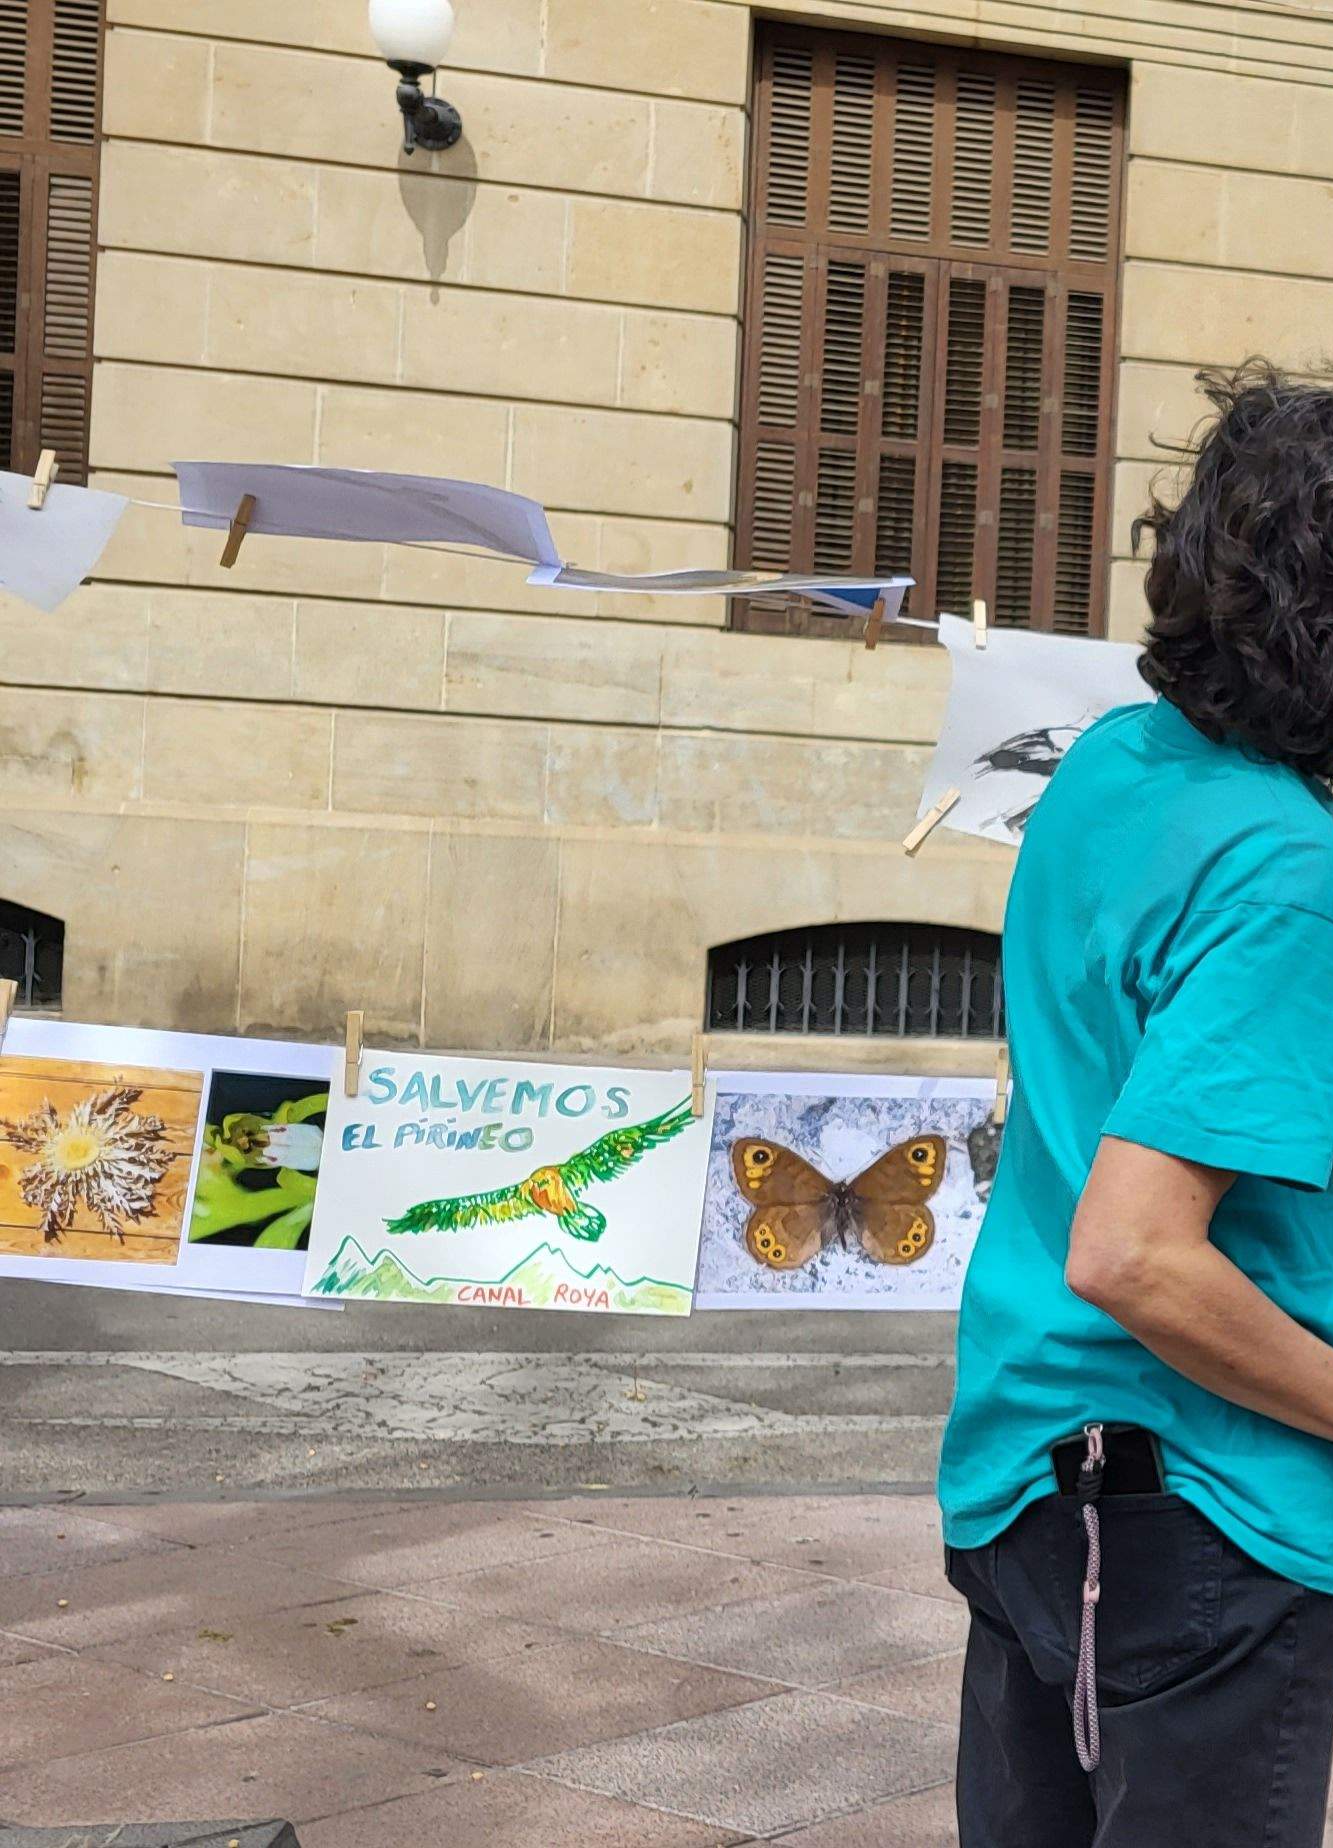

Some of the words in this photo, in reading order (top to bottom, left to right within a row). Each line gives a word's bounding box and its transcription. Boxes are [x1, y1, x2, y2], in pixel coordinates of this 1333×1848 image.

[368, 1067, 631, 1119] SALVEMOS
[341, 1123, 382, 1151] EL
[457, 1285, 532, 1306] CANAL
[554, 1284, 610, 1308] ROYA
